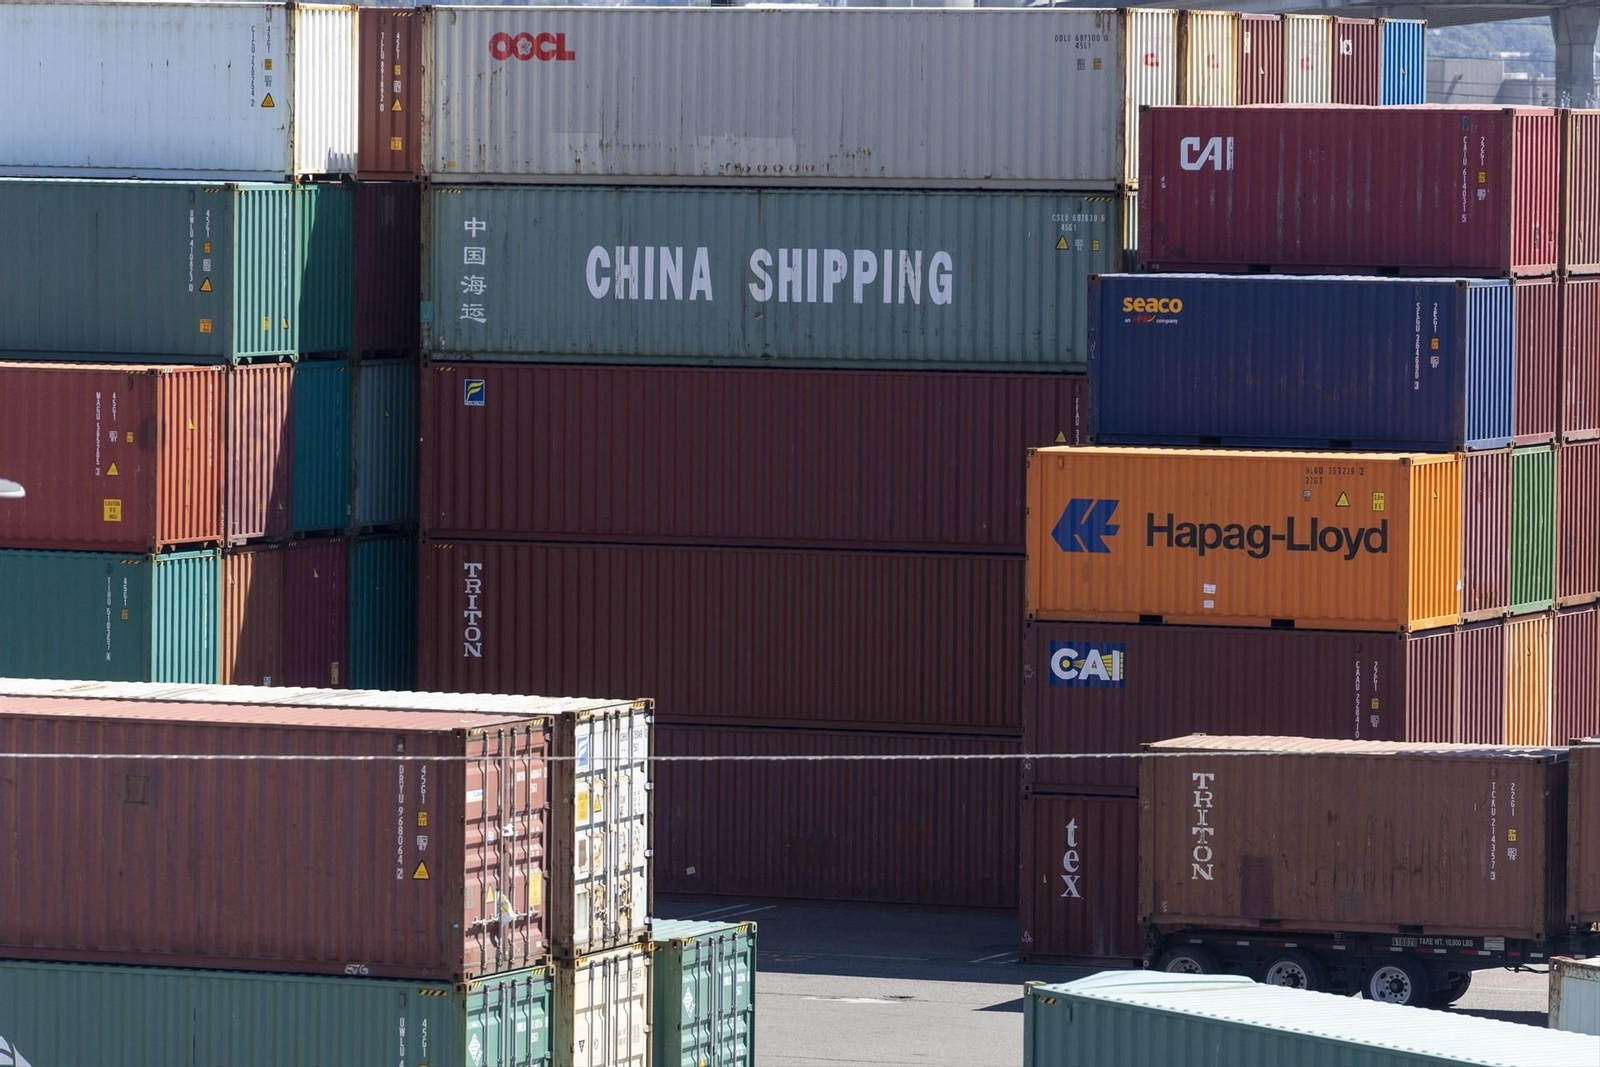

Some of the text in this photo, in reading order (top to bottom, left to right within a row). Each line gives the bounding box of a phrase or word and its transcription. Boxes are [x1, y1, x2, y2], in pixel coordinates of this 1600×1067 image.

[489, 32, 575, 62] OOCL
[1180, 137, 1234, 170] CAI
[1051, 213, 1069, 222] CSLU
[1060, 223, 1077, 231] 45G1
[1461, 214, 1467, 223] 5
[460, 216, 487, 324] 中国海运
[586, 246, 953, 305] CHINA SHIPPING
[1122, 297, 1183, 314] seaco
[1305, 477, 1323, 485] 22G1
[1359, 468, 1365, 476] 2
[1147, 513, 1388, 561] Hapag-Lloyd
[464, 563, 482, 657] TRITON
[1051, 648, 1120, 681] CAI
[1191, 773, 1214, 880] TRITON
[1061, 817, 1081, 898] tex
[397, 867, 404, 880] 2
[1490, 871, 1496, 880] 3
[1419, 937, 1433, 945] TARE
